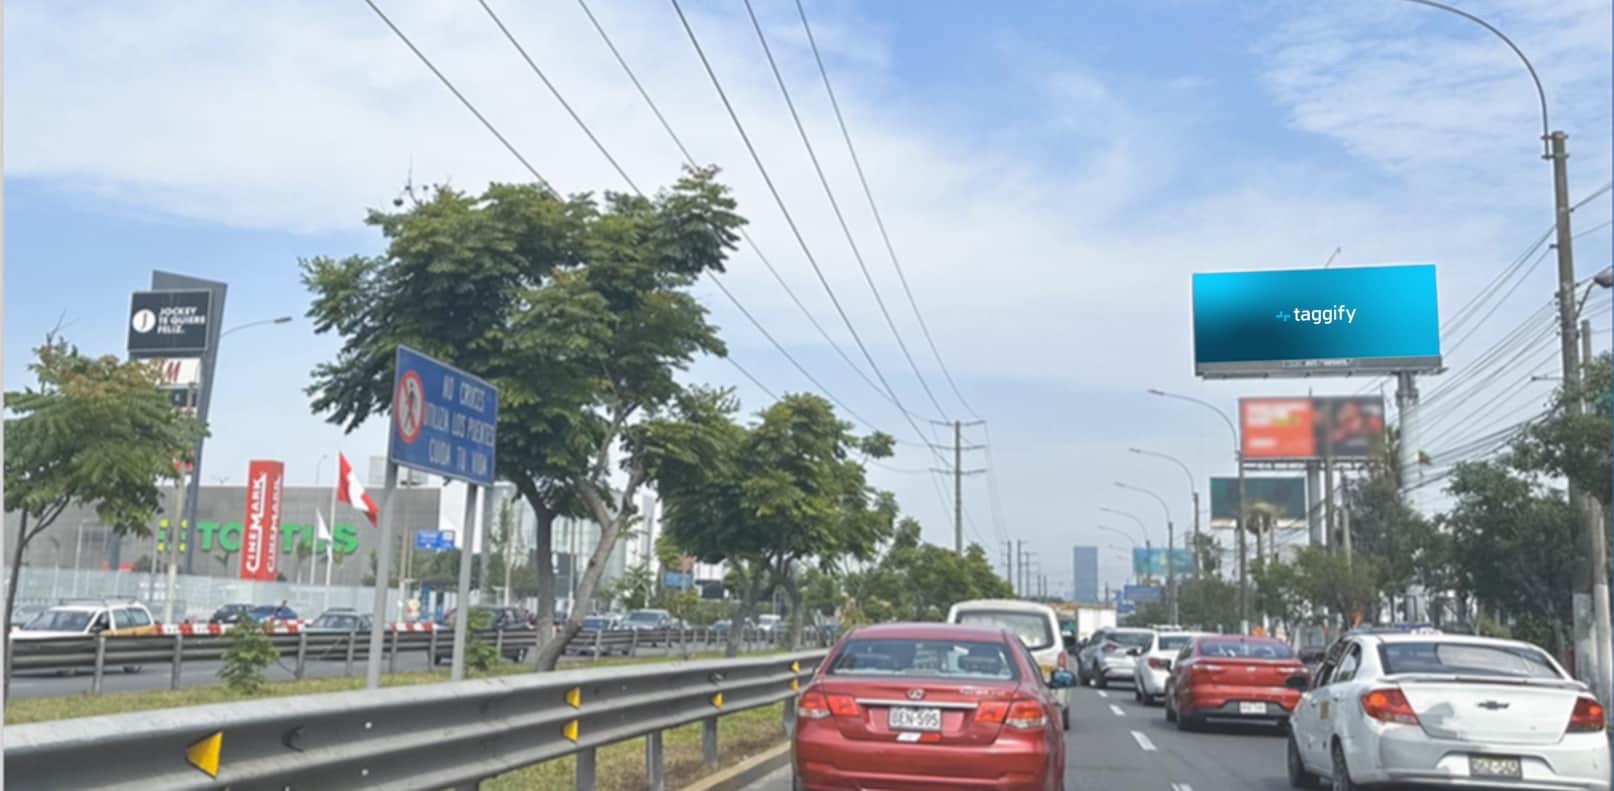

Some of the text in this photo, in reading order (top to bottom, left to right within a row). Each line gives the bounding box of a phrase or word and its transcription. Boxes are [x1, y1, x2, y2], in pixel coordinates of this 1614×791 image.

[160, 306, 197, 316] JOCKEY
[1294, 305, 1356, 324] taggify
[246, 472, 267, 573] CINEMARK
